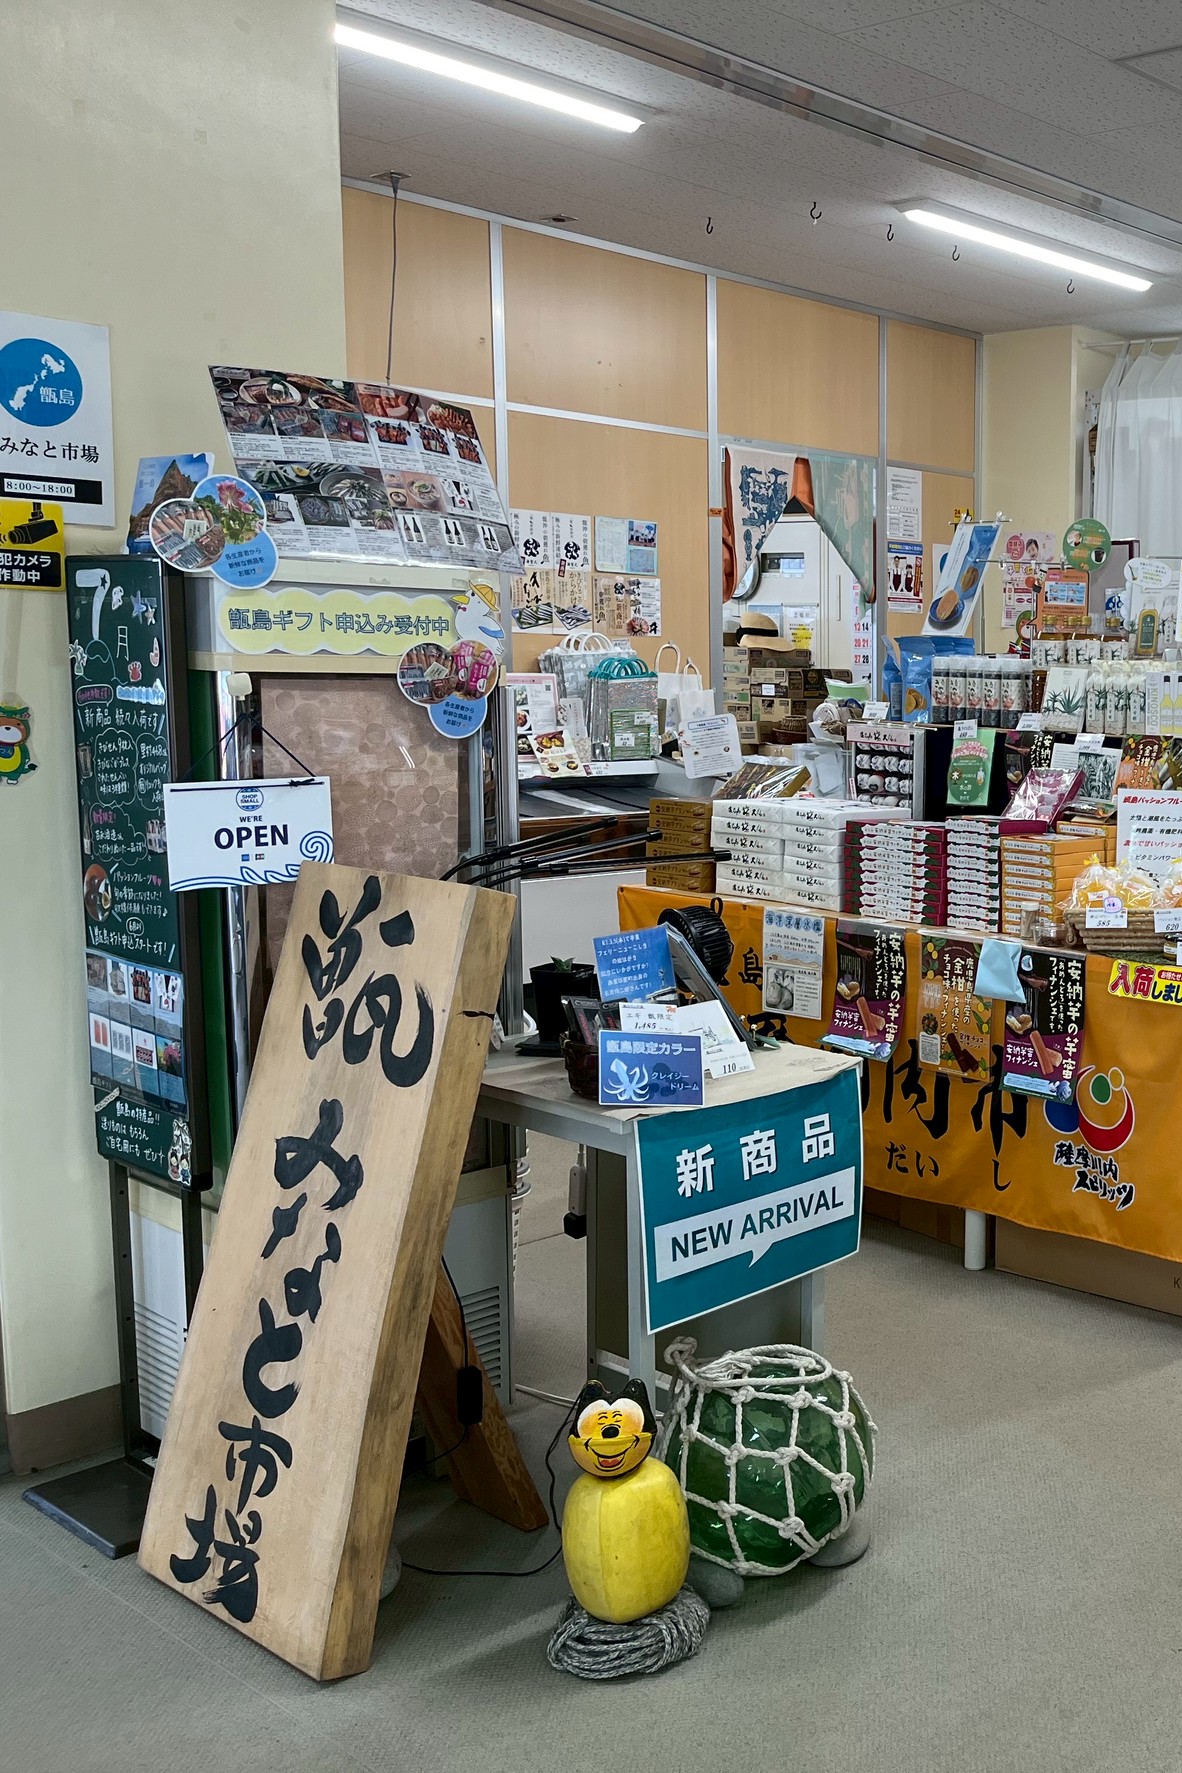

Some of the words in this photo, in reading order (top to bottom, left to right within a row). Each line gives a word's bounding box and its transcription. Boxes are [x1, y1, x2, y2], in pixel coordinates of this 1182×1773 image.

[40, 386, 75, 406] 甑島
[0, 437, 100, 464] みなと市場
[0, 552, 52, 567] 犯カメラ
[0, 569, 41, 583] 作動中
[228, 608, 450, 636] 甑島ギフト申込み受付中
[862, 623, 869, 632] 14
[116, 626, 129, 661] 月
[862, 639, 869, 648] 21
[239, 815, 263, 823] WE'RE
[214, 824, 289, 850] OPEN
[885, 932, 905, 1042] 安納芋の芋蜜
[833, 1018, 863, 1031] フィナンシェ
[1062, 959, 1083, 1080] 安納芋の芋蜜
[606, 1039, 696, 1056] 甑島限定カラー
[722, 1063, 737, 1075] 110
[1005, 1054, 1038, 1068] フィナンシェ
[651, 1072, 690, 1080] クレイジー
[670, 1083, 700, 1091] ドリーム
[885, 1141, 939, 1178] だい
[992, 1159, 1012, 1192] し
[1073, 1169, 1135, 1211] スピリッツ
[671, 1220, 734, 1262] NEW
[740, 1186, 844, 1240] ARRIVAL
